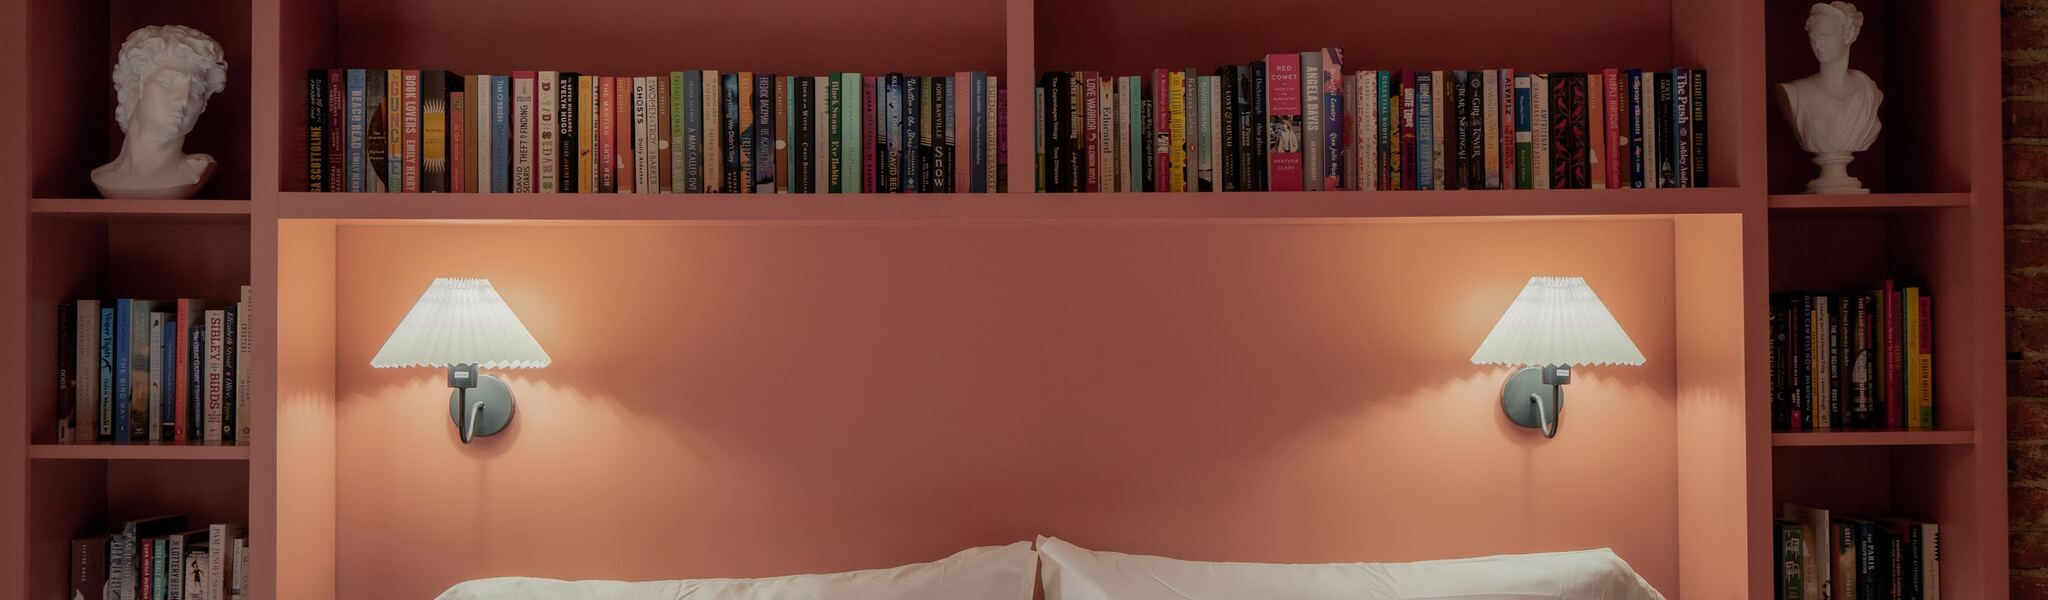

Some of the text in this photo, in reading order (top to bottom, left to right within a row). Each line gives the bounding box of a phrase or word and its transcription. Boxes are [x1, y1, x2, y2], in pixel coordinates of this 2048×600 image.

[405, 75, 416, 133] BOOK LOVERS
[726, 85, 735, 118] Everything
[760, 77, 769, 124] FREDRIK BACKMAN
[1087, 78, 1096, 130] LOVE WARRIOR
[1173, 90, 1183, 141] YELLOW HOUSE
[1306, 66, 1318, 131] ANGELA DAVIS
[1328, 98, 1336, 122] Country
[1403, 108, 1414, 128] TIGER
[1420, 83, 1430, 140] HOMELAND ELEGIES
[1471, 97, 1481, 119] GIRL
[1609, 74, 1618, 129] PURPLE HIBISCUS
[1677, 73, 1688, 124] The Push
[1694, 73, 1704, 121] MARGARET ATWOOD
[352, 90, 362, 149] BEACH READ
[520, 105, 528, 134] FINDING
[728, 119, 734, 130] We
[1103, 107, 1111, 153] Educated
[1457, 116, 1466, 159] NIGHTINGALE
[310, 126, 322, 180] SCOTTOLINE
[520, 141, 528, 163] THEFT
[542, 131, 553, 189] SEDARIS
[688, 135, 696, 150] MAN
[727, 151, 735, 163] Say
[760, 137, 769, 159] AGAINST
[1471, 127, 1481, 158] TOWER
[406, 140, 416, 190] EMILY HENRY
[832, 158, 840, 186] Babitz
[1328, 162, 1337, 178] Wang
[1420, 161, 1430, 184] AKHTAR
[102, 313, 112, 358] Vesper Flights
[210, 317, 220, 409] SIBLEY BIRDS
[112, 542, 122, 559] LISA
